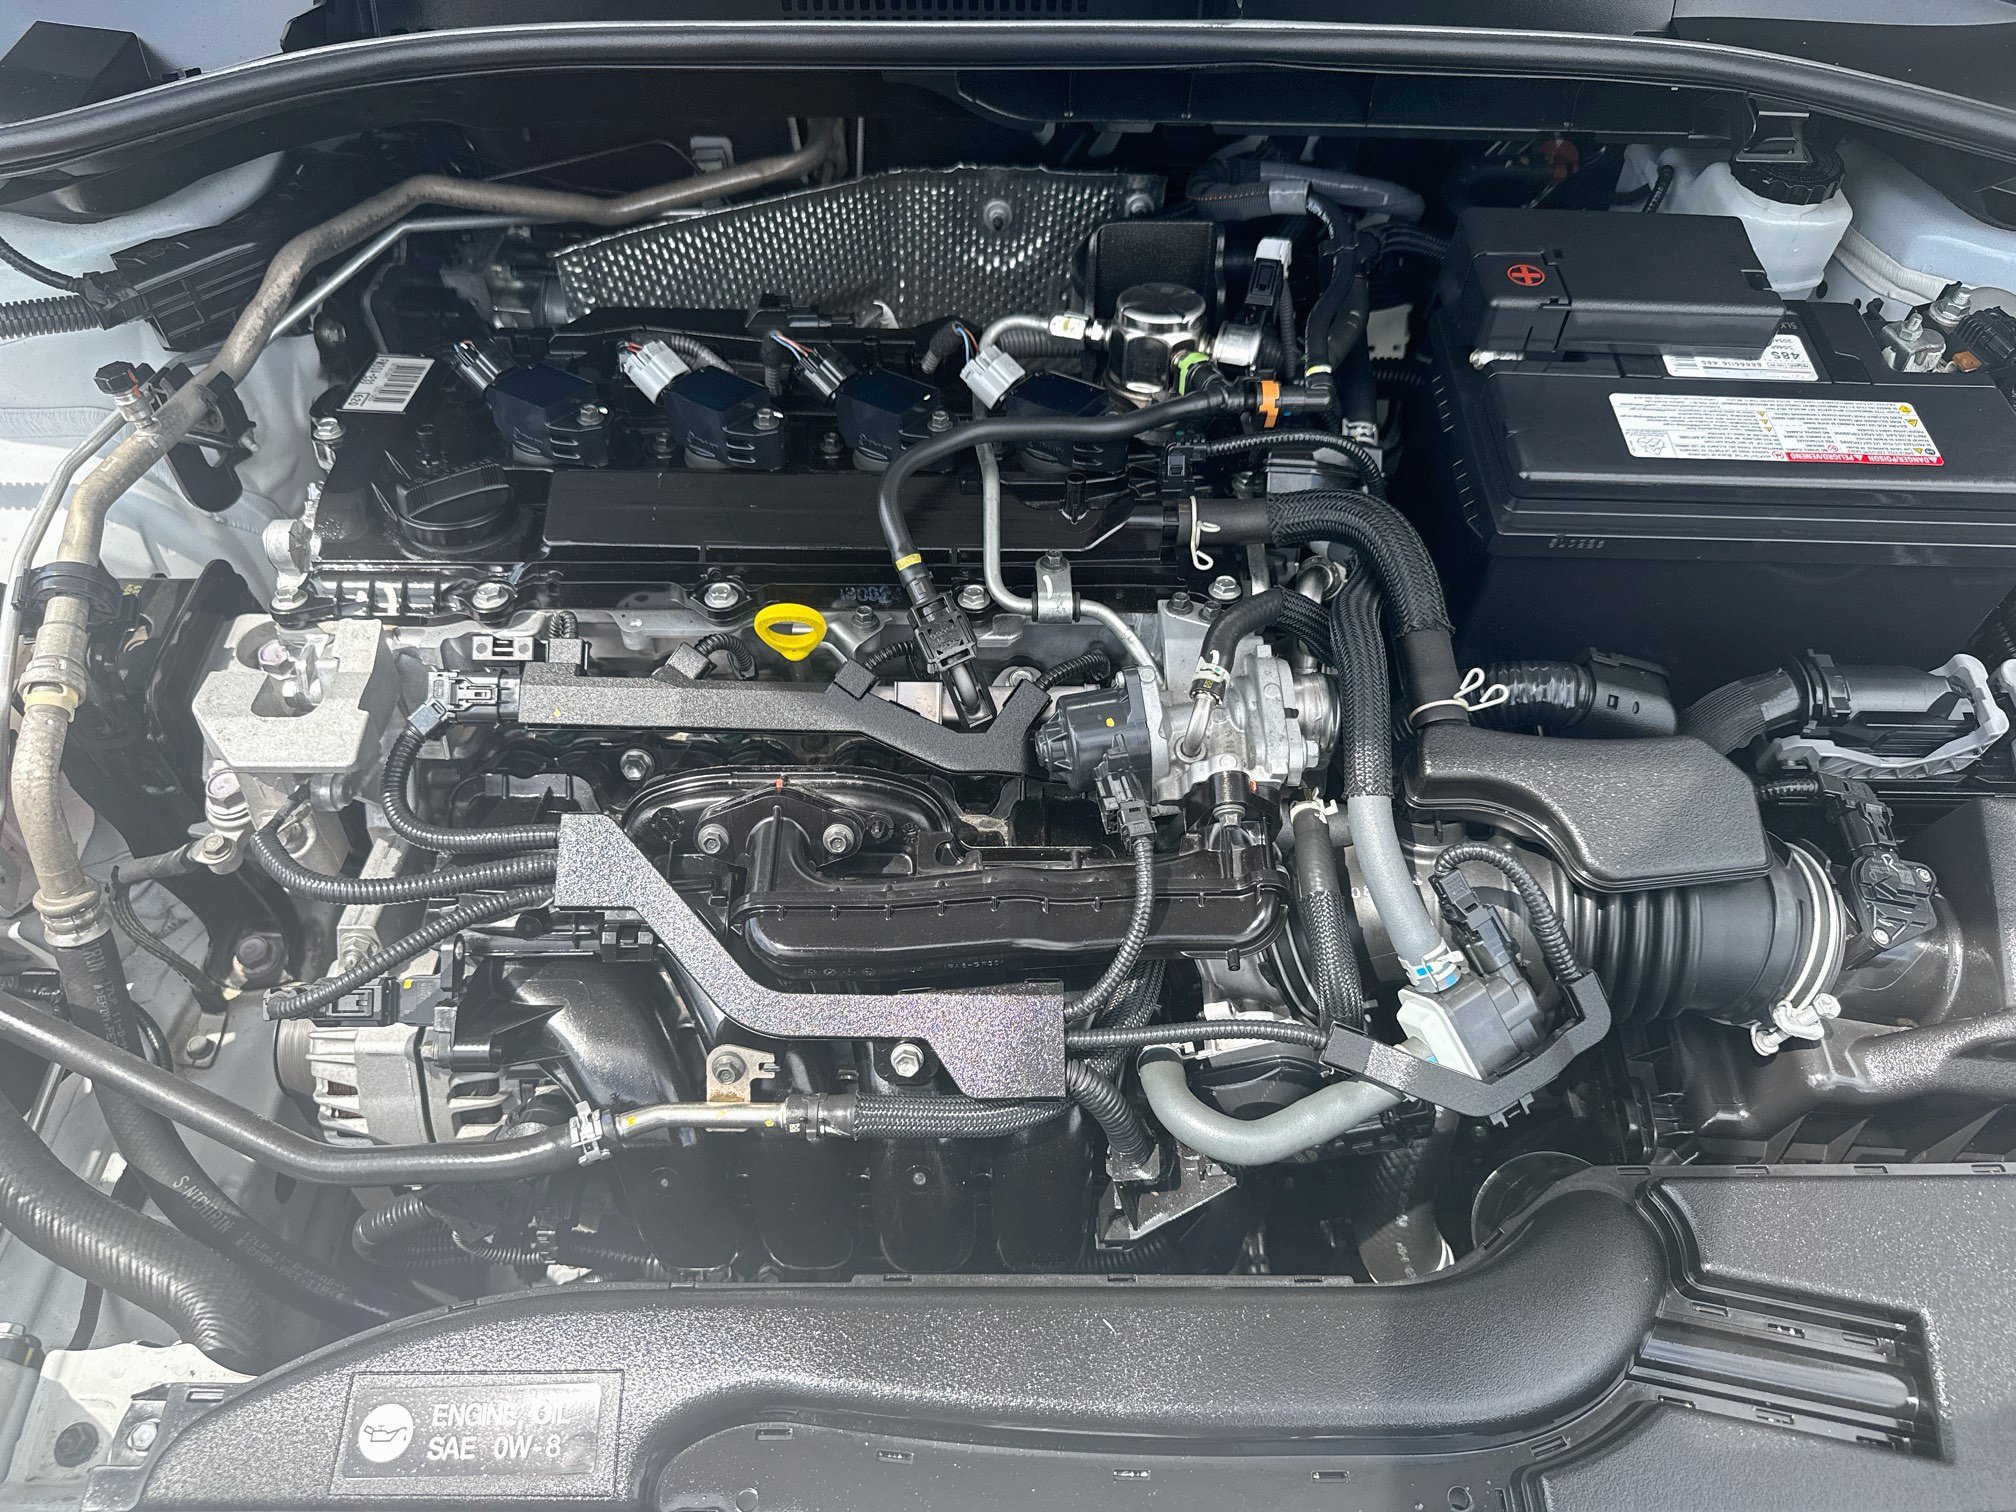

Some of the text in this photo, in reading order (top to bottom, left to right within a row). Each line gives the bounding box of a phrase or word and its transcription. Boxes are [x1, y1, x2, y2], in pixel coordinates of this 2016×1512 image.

[1771, 351, 1800, 360] 48S
[430, 1400, 571, 1426] ENGINE OIL
[426, 1434, 562, 1461] SAE 0W-8
